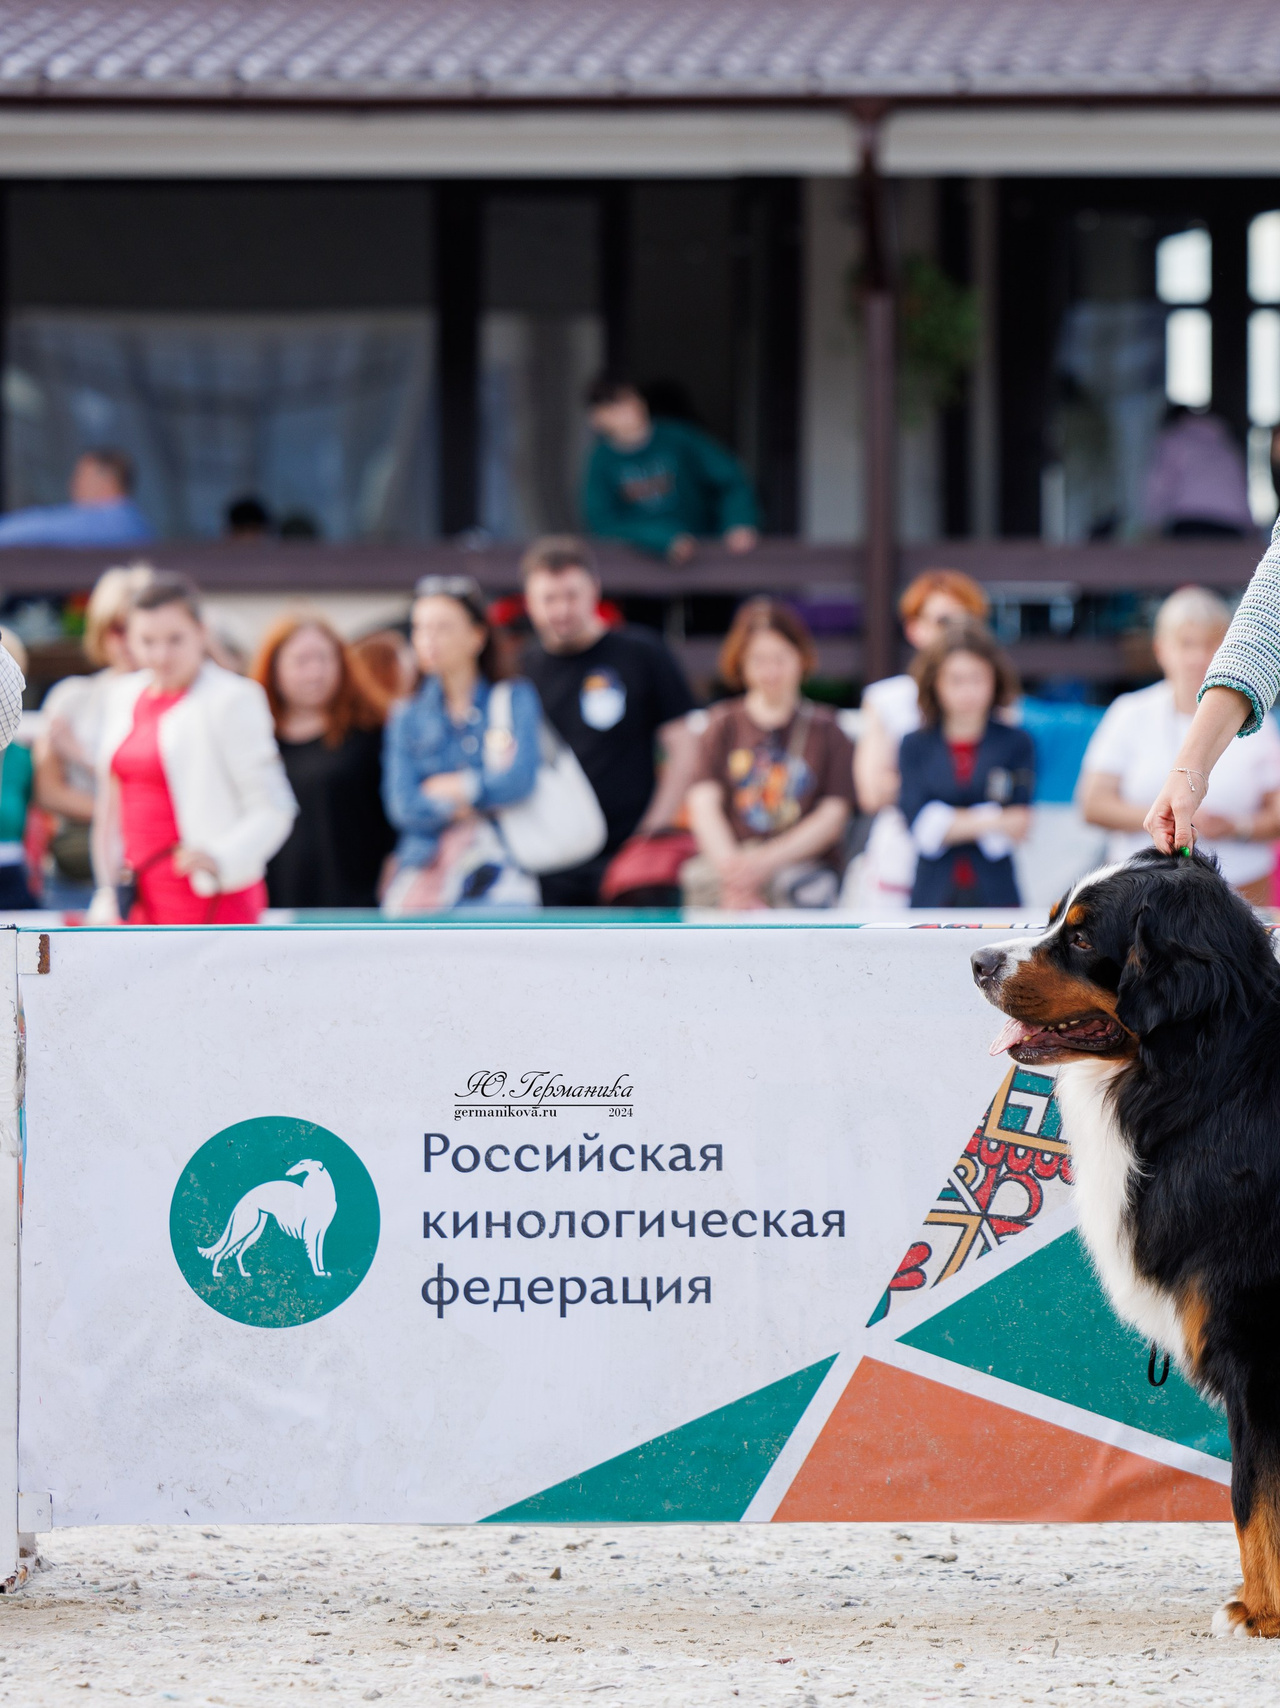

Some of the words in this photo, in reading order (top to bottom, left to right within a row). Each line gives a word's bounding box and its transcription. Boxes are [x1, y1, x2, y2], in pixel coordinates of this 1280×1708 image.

[423, 1132, 723, 1173] Российская
[423, 1209, 845, 1239] кинологическая
[421, 1262, 711, 1319] федерация
